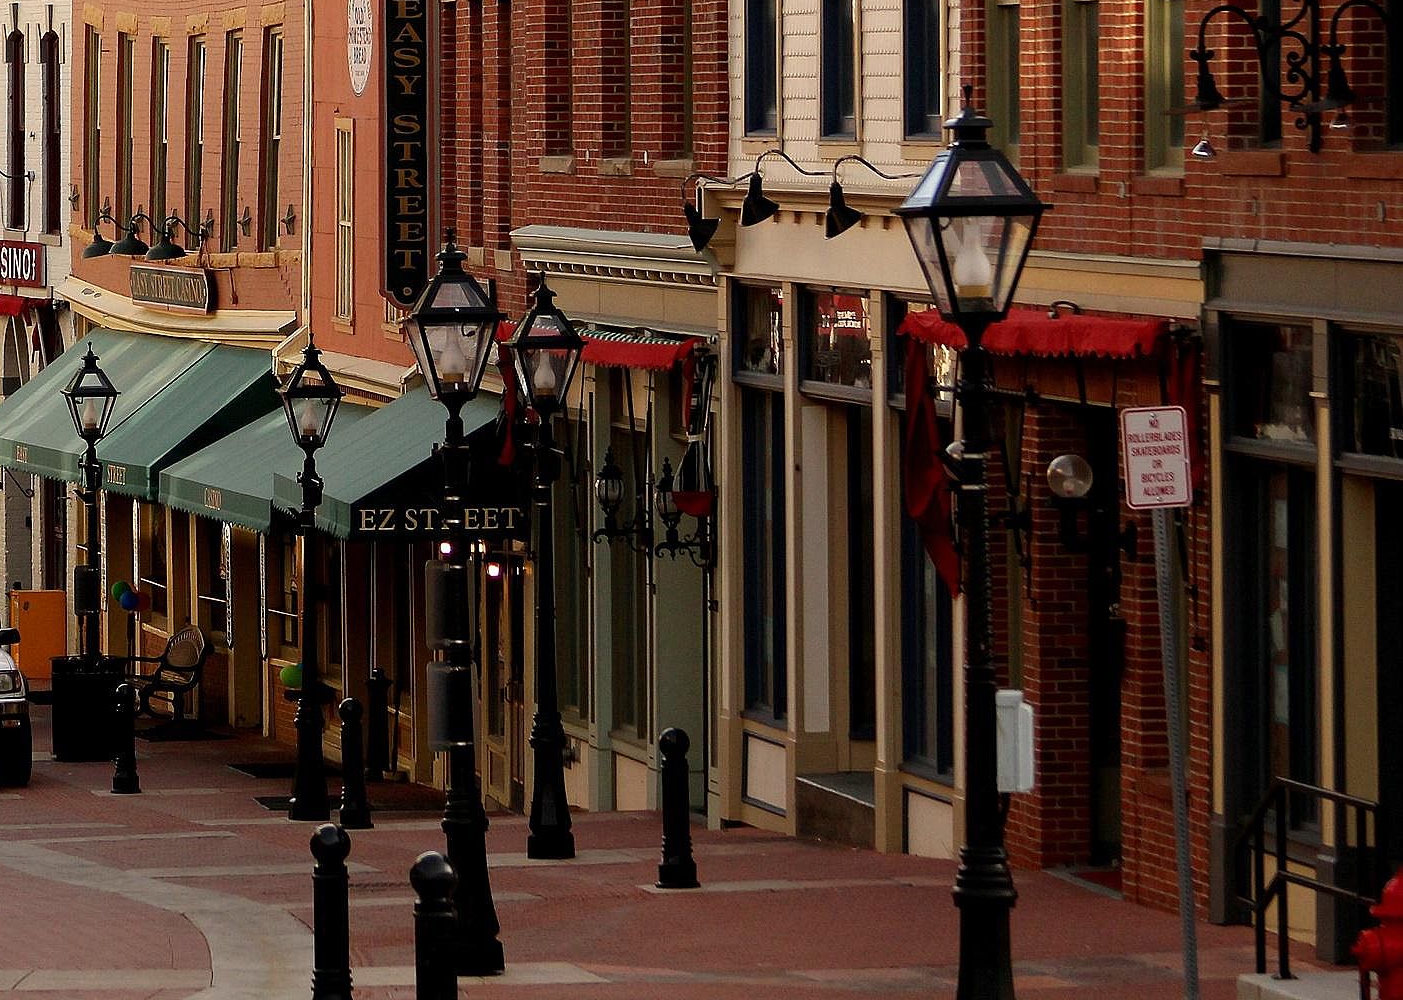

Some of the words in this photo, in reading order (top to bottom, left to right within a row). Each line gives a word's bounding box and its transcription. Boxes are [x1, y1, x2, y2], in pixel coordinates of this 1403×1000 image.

[393, 114, 425, 270] STREET
[150, 273, 175, 300] STREET
[177, 276, 203, 304] CASINO
[1127, 431, 1183, 443] ROLLERBLADES
[1131, 445, 1181, 457] SKATEBOARDS
[1152, 459, 1163, 469] OR
[107, 464, 126, 485] STREET
[1141, 472, 1175, 483] BICYCLES
[1142, 485, 1175, 497] ALLOWED
[358, 508, 396, 531] EZ
[404, 507, 521, 531] STEET
